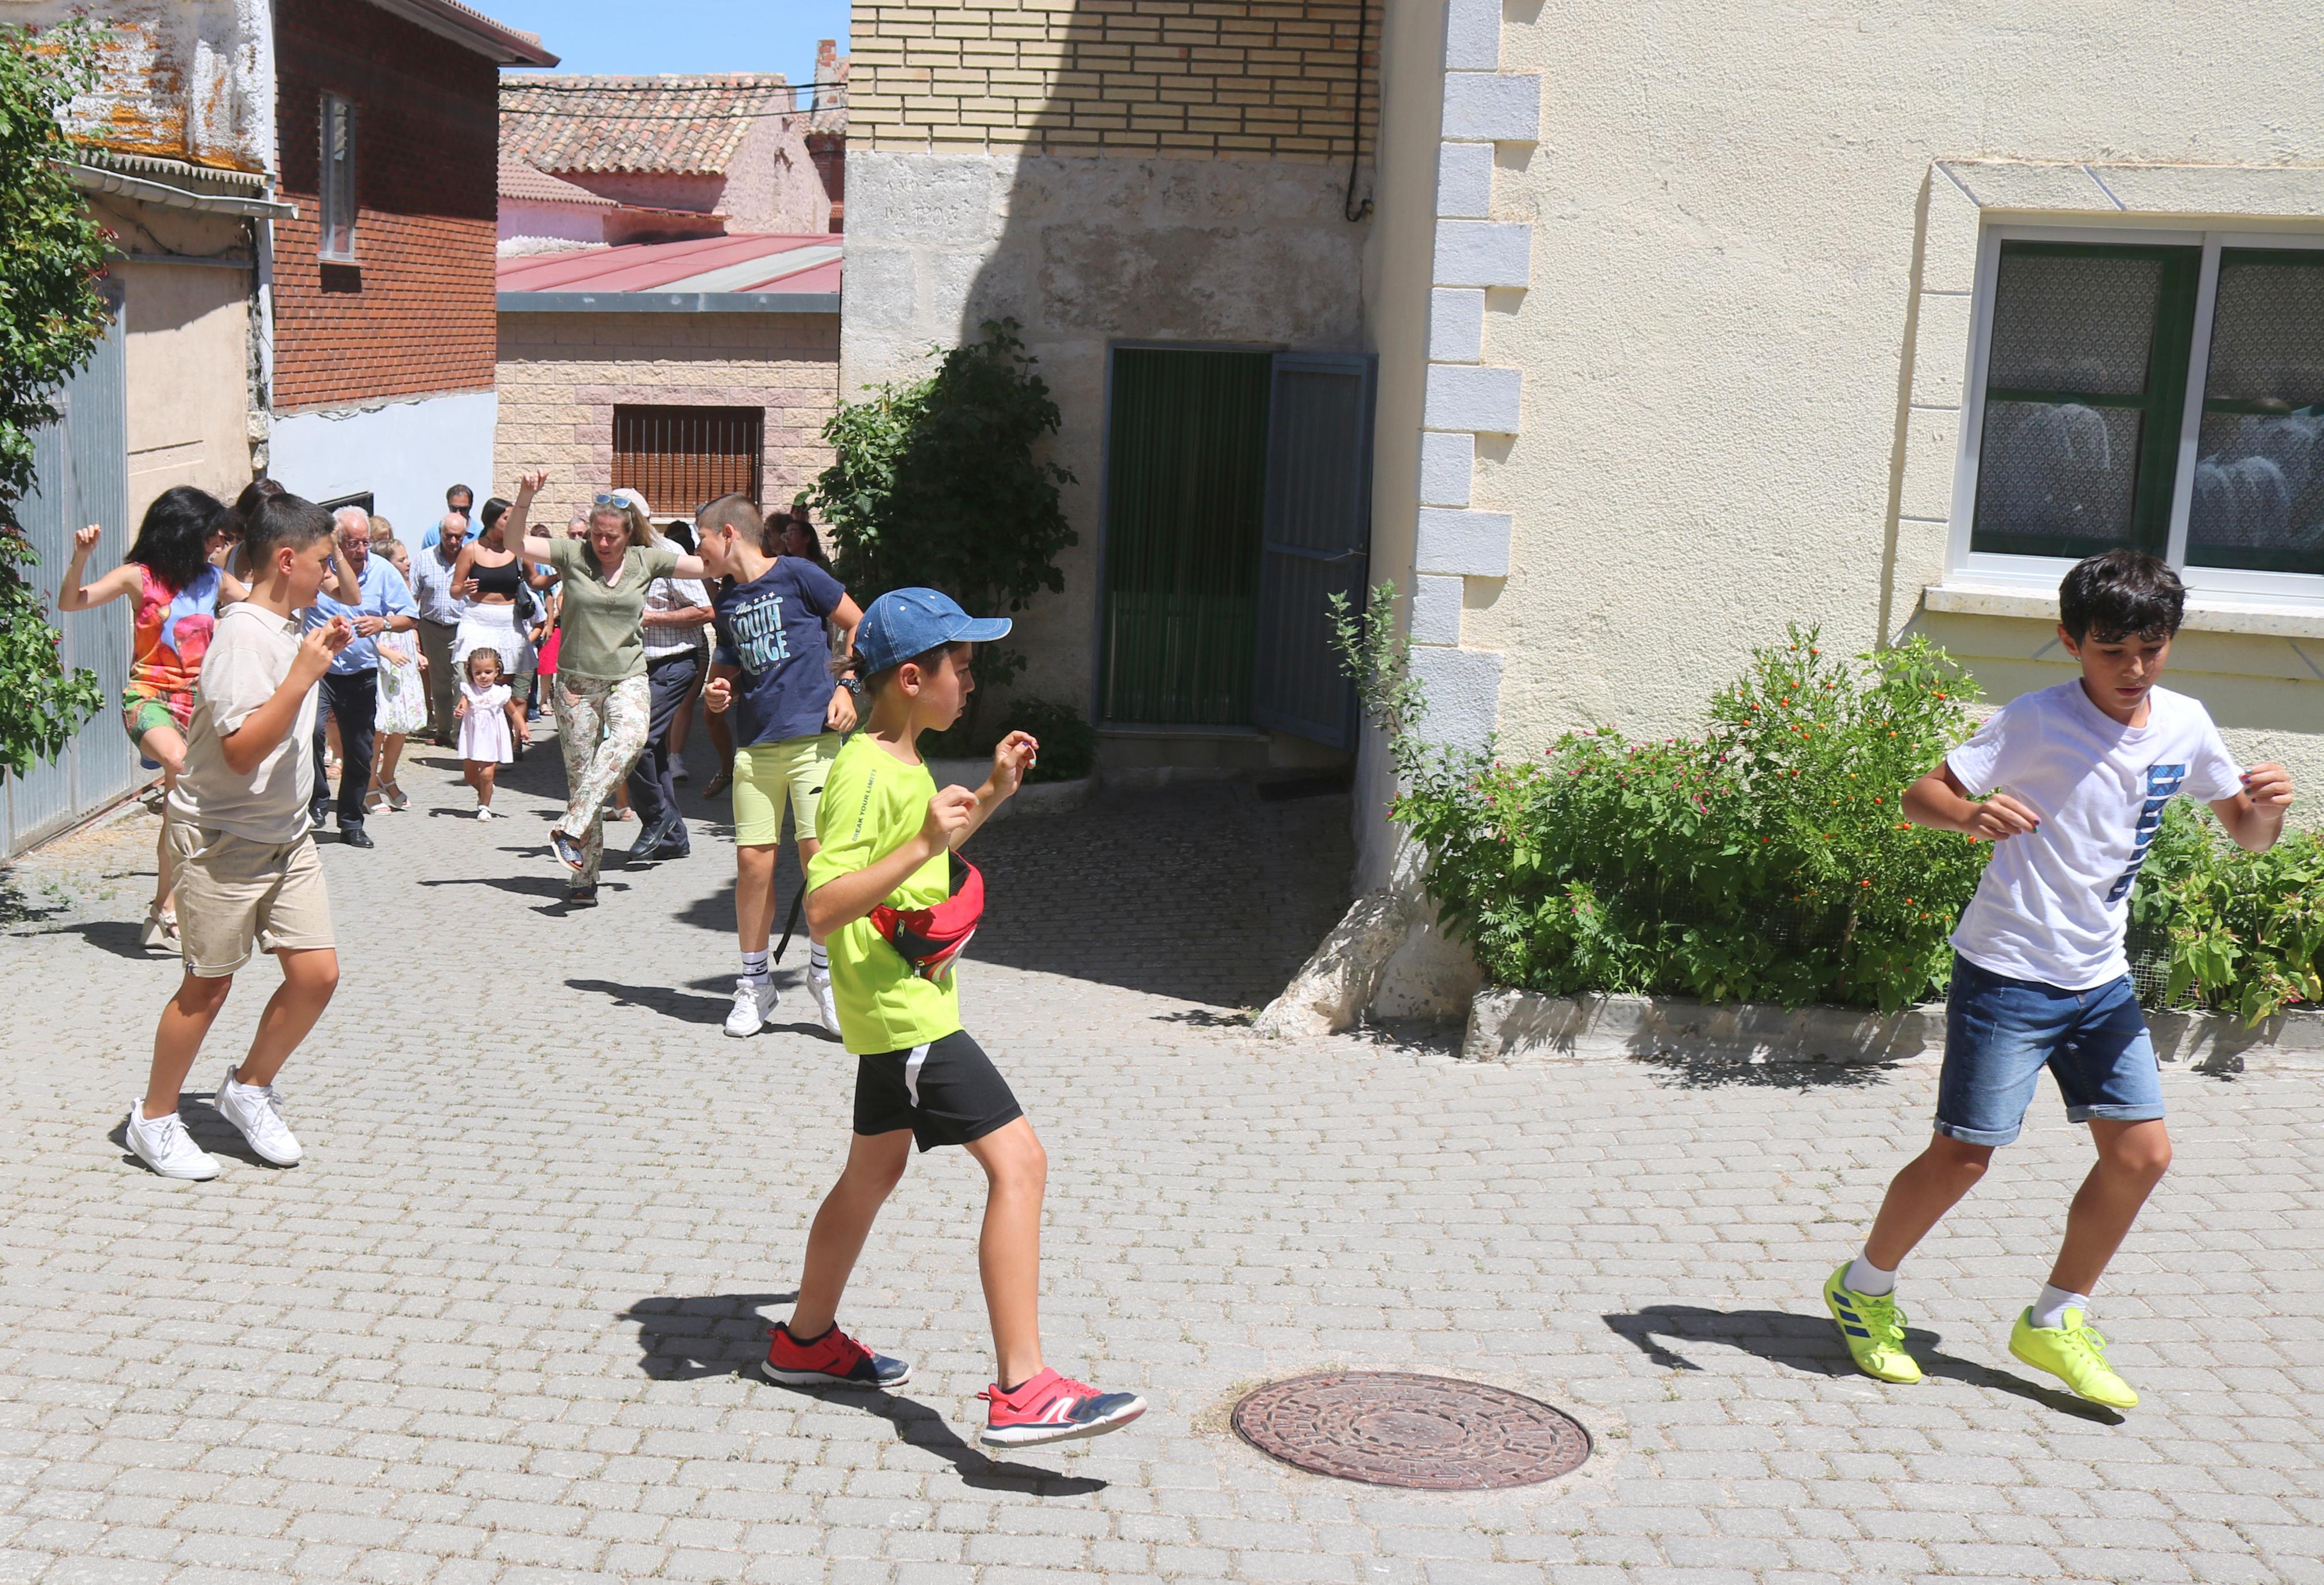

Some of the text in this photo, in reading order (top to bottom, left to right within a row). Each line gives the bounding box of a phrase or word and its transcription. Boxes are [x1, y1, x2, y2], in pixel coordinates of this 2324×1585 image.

[729, 596, 783, 643] SOUTH
[852, 769, 877, 841] BREAK YOUR LIMITS
